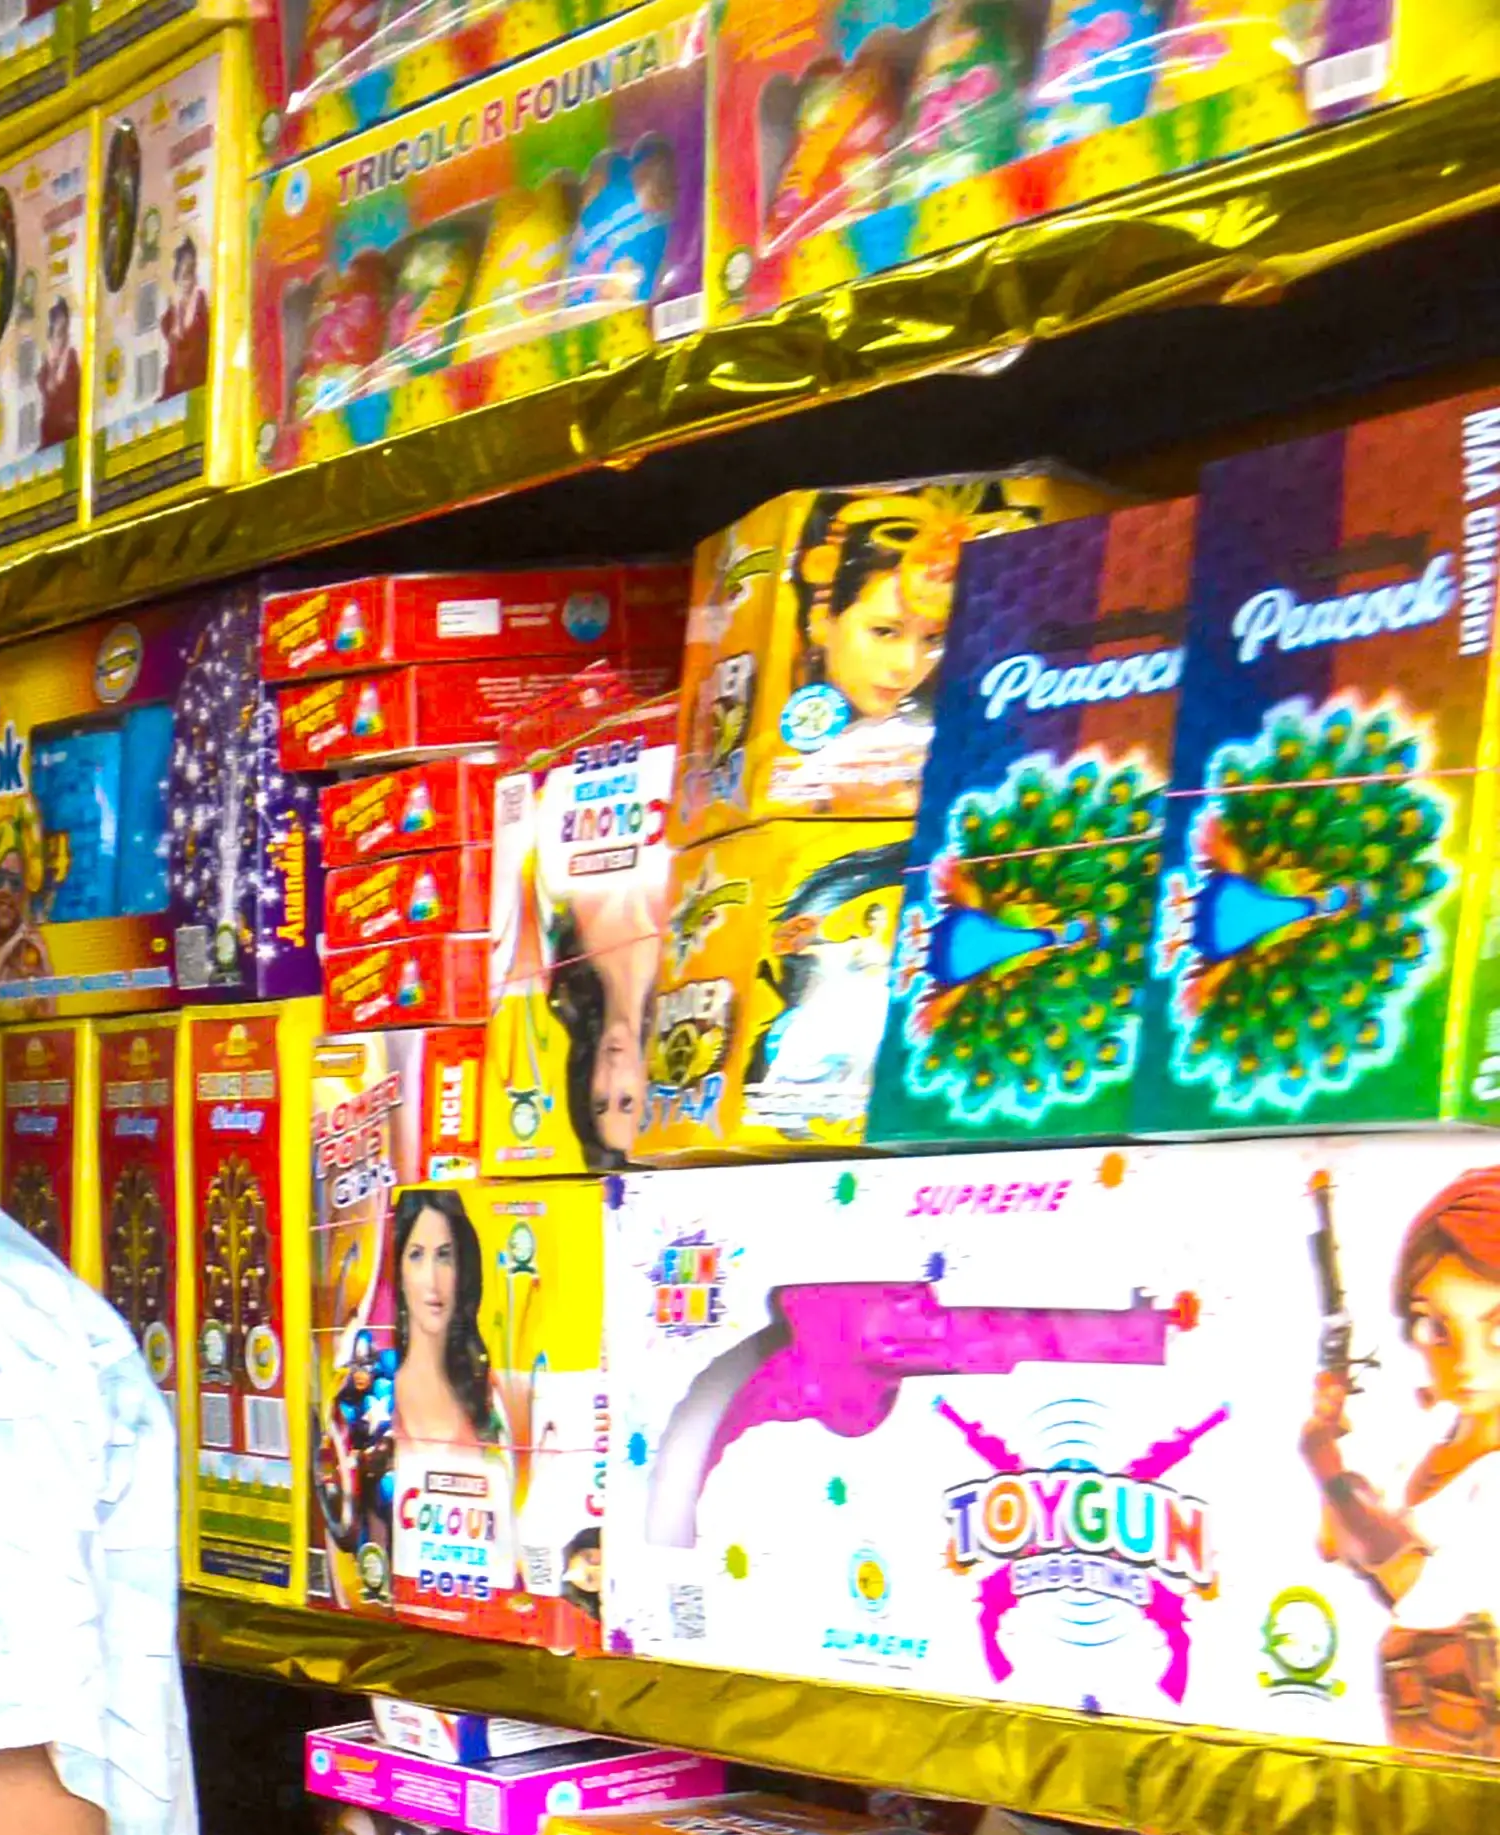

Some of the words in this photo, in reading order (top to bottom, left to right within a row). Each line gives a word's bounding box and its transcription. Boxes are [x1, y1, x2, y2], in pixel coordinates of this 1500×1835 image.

[1460, 408, 1500, 498] MAA
[1232, 552, 1456, 663] Peacock
[980, 645, 1187, 720] Peacoc
[311, 1070, 402, 1140] LOWER
[904, 1179, 1075, 1218] SUPREME
[398, 1486, 496, 1542] COLOUR
[947, 1476, 1208, 1576] TOYGUN
[419, 1540, 488, 1567] FLOWER
[1012, 1556, 1150, 1605] SHOOTING
[418, 1568, 490, 1600] POTS
[821, 1627, 930, 1659] SUPREME
